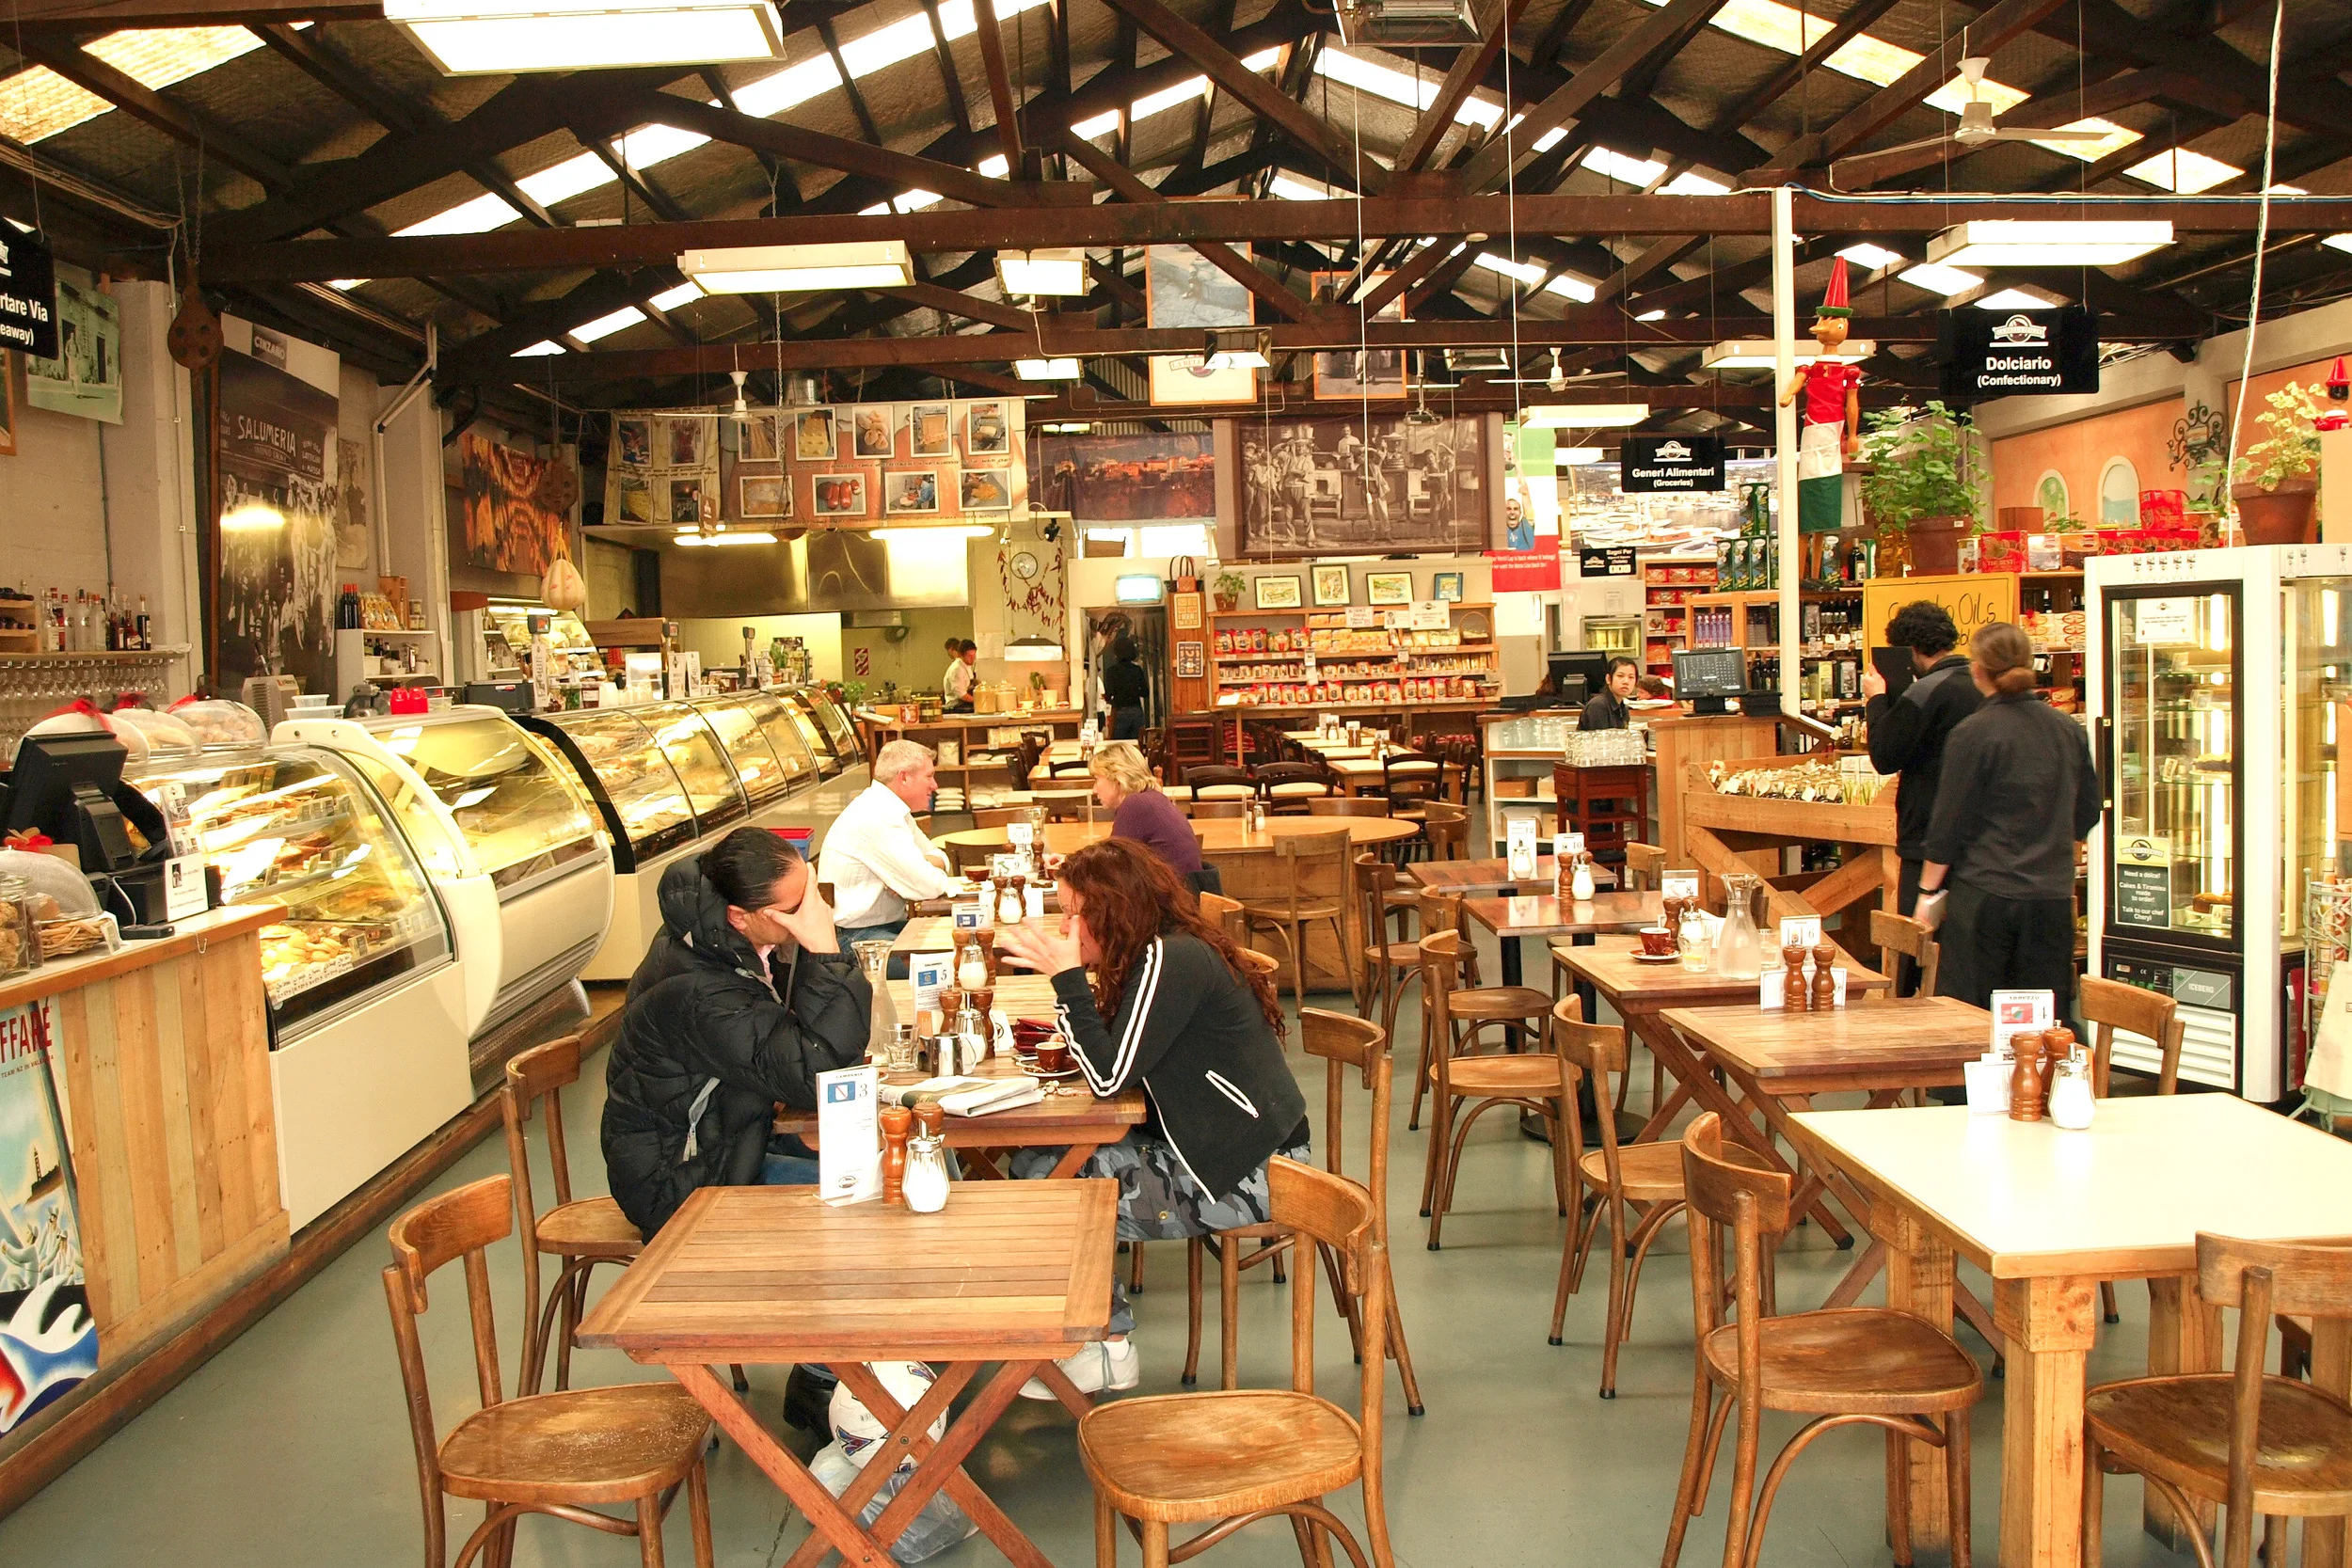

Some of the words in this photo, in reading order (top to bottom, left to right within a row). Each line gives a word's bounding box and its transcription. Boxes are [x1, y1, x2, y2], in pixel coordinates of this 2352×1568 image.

[29, 299, 48, 322] Via
[254, 336, 285, 360] CINZANO
[1985, 356, 2052, 371] Dolciario
[1977, 373, 2061, 388] (Confectionary)
[237, 415, 296, 457] SALUMERIA
[1632, 467, 1664, 478] Generi
[1665, 467, 1715, 478] Alimentari
[1653, 479, 1693, 488] (Groceries)
[978, 914, 985, 924] 7
[1808, 927, 1815, 939] 6
[941, 969, 947, 981] 5
[2188, 983, 2215, 993] ICEBERG
[1, 1069, 15, 1079] TEAM
[859, 1084, 868, 1098] 3
